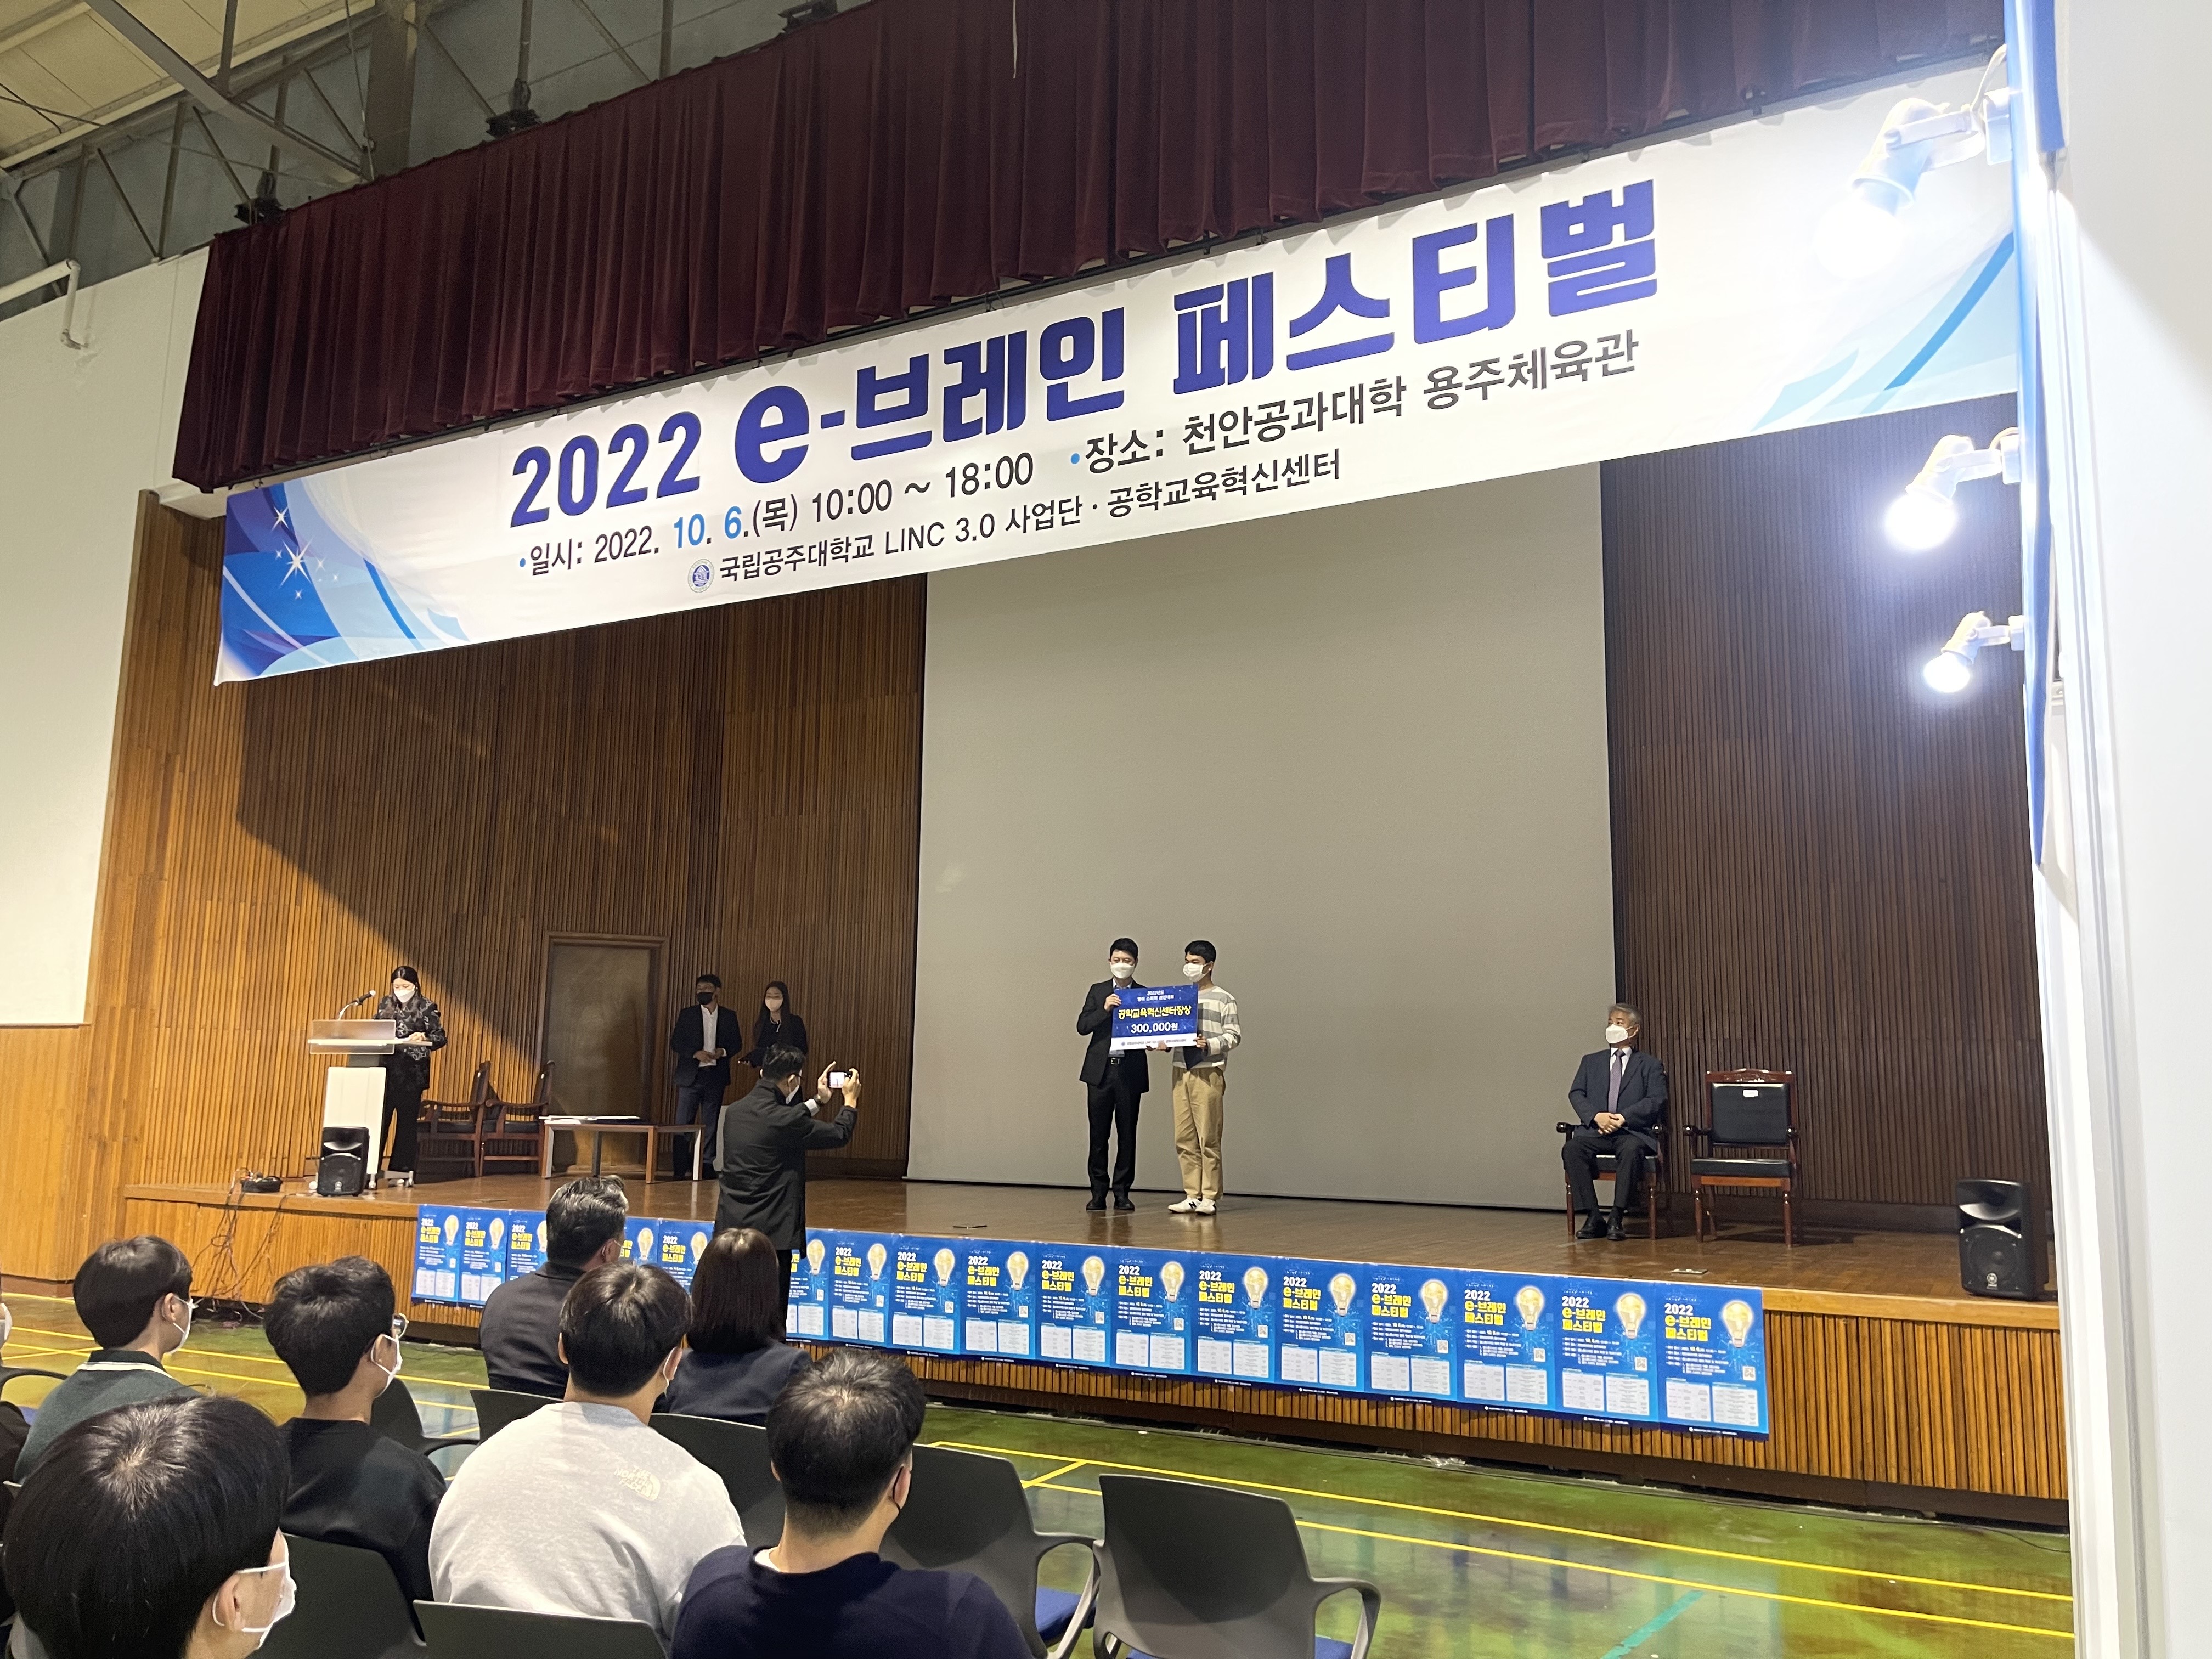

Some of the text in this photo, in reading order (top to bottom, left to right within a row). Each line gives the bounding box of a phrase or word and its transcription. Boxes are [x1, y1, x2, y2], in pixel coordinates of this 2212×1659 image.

[511, 179, 1657, 528] 2022 e-브레인 페스티벌
[530, 538, 583, 576] 일시:
[594, 525, 660, 564] 2022.
[673, 513, 712, 549] 10.
[811, 479, 893, 522] 10:00
[945, 453, 1034, 498] 18:00
[1084, 428, 1164, 473] 장소:
[1184, 375, 1407, 456] 천안공과대학
[1423, 330, 1639, 410] 용주체육관
[719, 535, 875, 582] 국립공주대학교
[885, 522, 945, 555] LINC
[955, 514, 994, 543] 3.0
[1005, 495, 1083, 533] 사업단
[1107, 448, 1341, 518] 공학교육혁신센터
[1131, 1022, 1178, 1034] 300,000원
[663, 1235, 678, 1244] 2022
[836, 1246, 852, 1256] 2022
[898, 1251, 916, 1261] 2022
[968, 1256, 988, 1266] 2022
[1042, 1260, 1062, 1270] 2022
[1119, 1265, 1140, 1275] 2022
[1199, 1271, 1222, 1281] 2022
[1283, 1276, 1307, 1287] 2022
[1372, 1283, 1396, 1294] 2022
[1464, 1289, 1491, 1301] 2022
[1562, 1296, 1589, 1308] 2022
[1664, 1303, 1693, 1316] 2022
